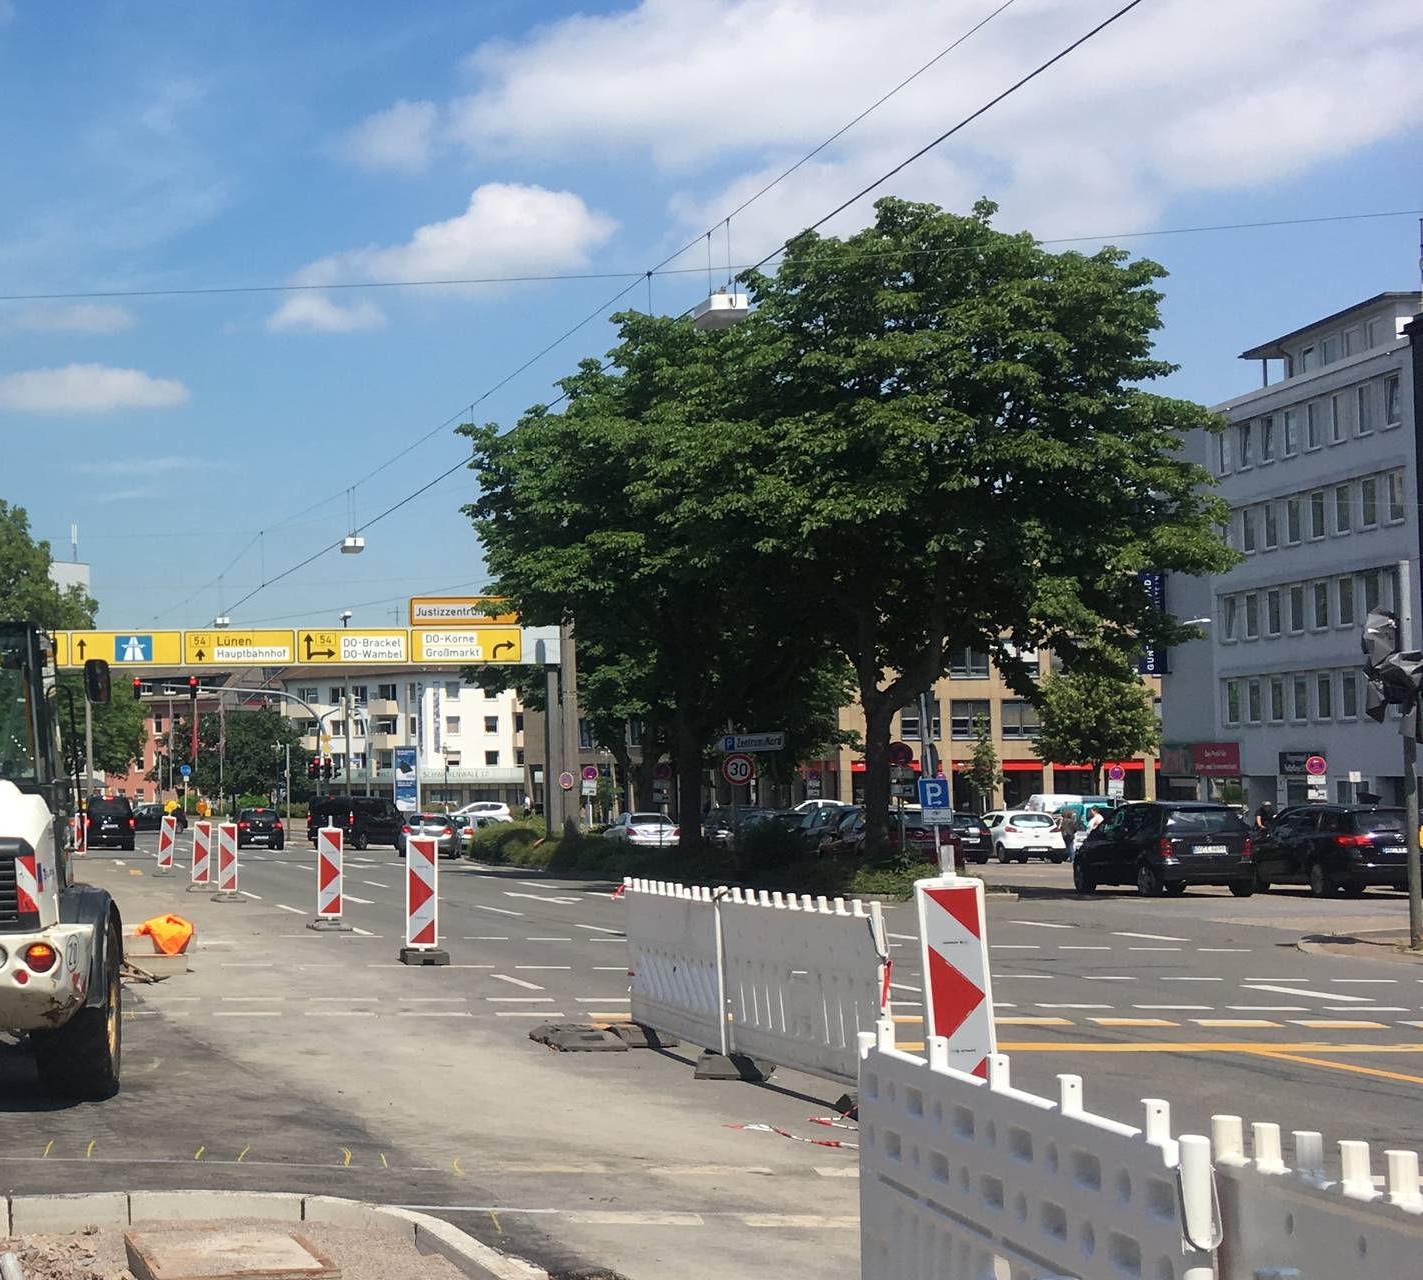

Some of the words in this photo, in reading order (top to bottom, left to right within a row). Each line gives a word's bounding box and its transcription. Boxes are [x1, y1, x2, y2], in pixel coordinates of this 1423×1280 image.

[193, 636, 207, 645] 54
[217, 635, 252, 647] Lünen
[319, 635, 332, 644] 54
[343, 638, 401, 648] DO-Brackel
[217, 648, 286, 660] Hauptbahnhof
[343, 649, 403, 659] DO-Wambel
[425, 648, 480, 657] Großmarkt
[730, 762, 748, 777] 30
[925, 783, 943, 806] P
